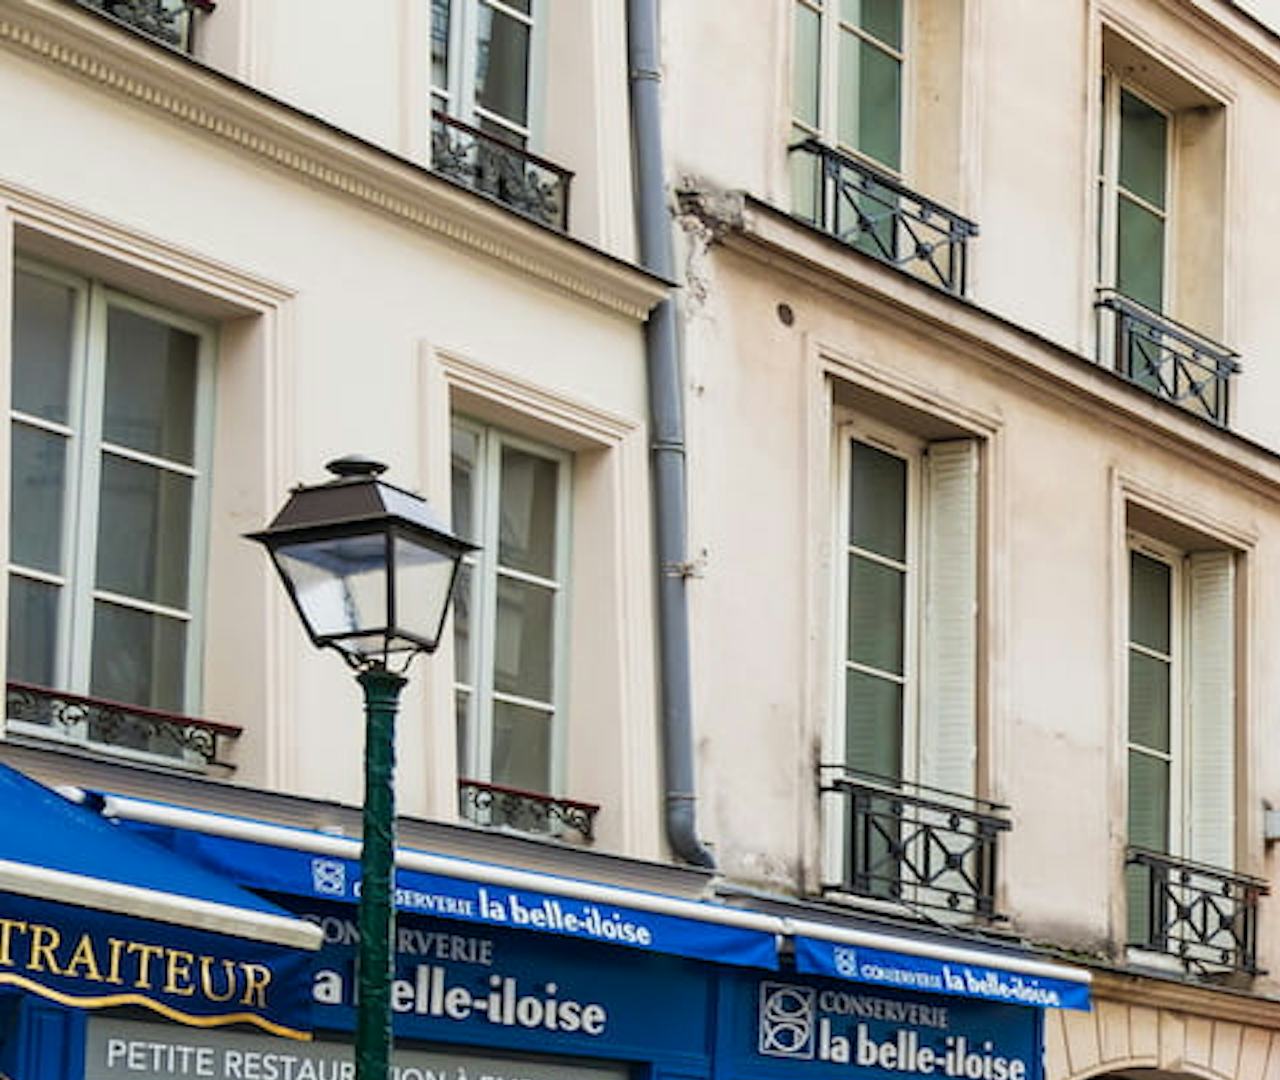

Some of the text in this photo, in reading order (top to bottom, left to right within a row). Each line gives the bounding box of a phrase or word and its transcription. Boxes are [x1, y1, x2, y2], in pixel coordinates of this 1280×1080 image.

[353, 882, 653, 947] CSERVERIE la belle-iloise
[302, 913, 494, 966] ONRVERIE
[0, 919, 273, 1009] TRAITEUR
[943, 964, 965, 989] la
[313, 969, 343, 1004] a
[820, 990, 948, 1028] CONSERVERIE
[106, 1038, 215, 1077] PETITE
[820, 1017, 850, 1064] la
